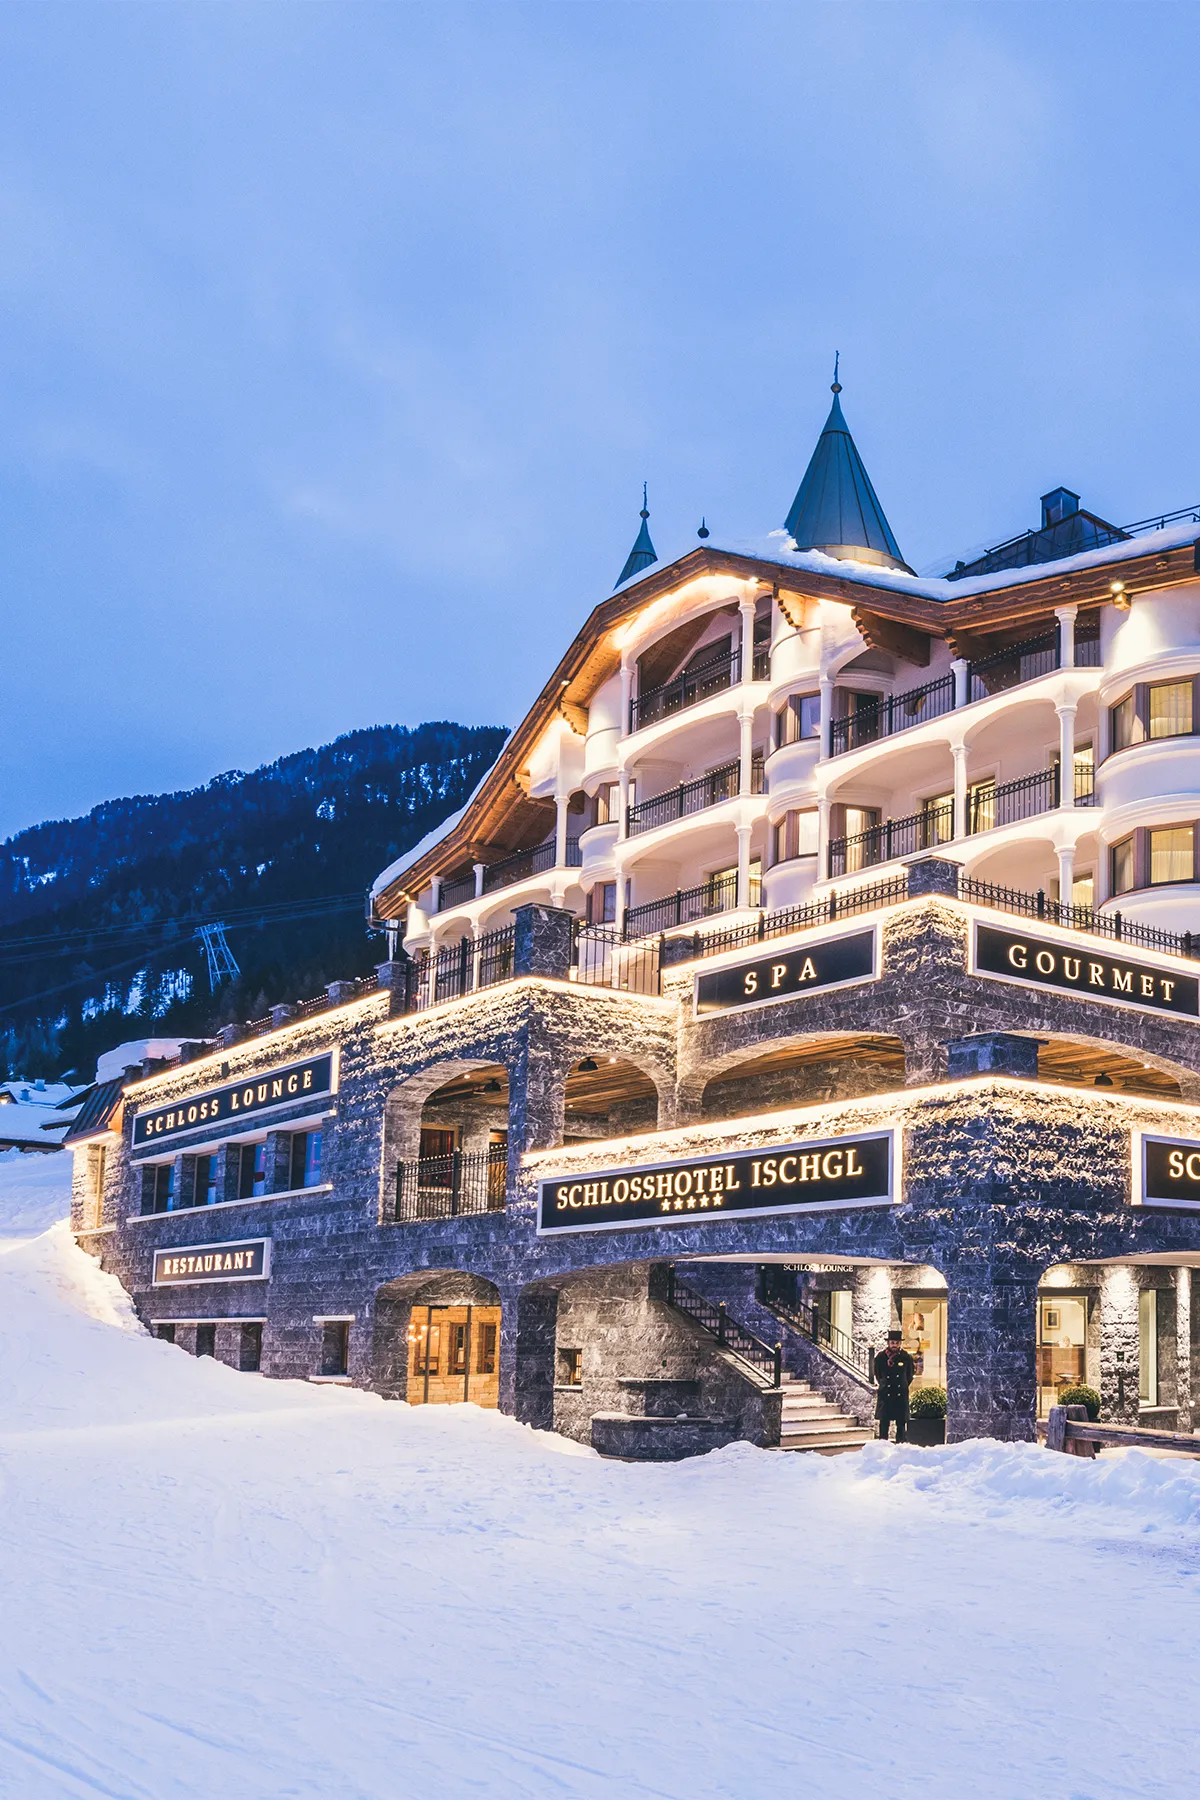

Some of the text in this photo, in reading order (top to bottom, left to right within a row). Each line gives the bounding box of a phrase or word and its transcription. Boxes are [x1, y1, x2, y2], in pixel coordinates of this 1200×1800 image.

[744, 957, 817, 995] SPA
[1008, 944, 1175, 1002] GOURMET
[145, 1069, 313, 1136] SCHLOSS LOUNGE
[556, 1148, 863, 1210] SCHLOSSHOTEL ISCHGL
[163, 1250, 255, 1275] RESTAURANT
[820, 1264, 854, 1273] LOUNGE
